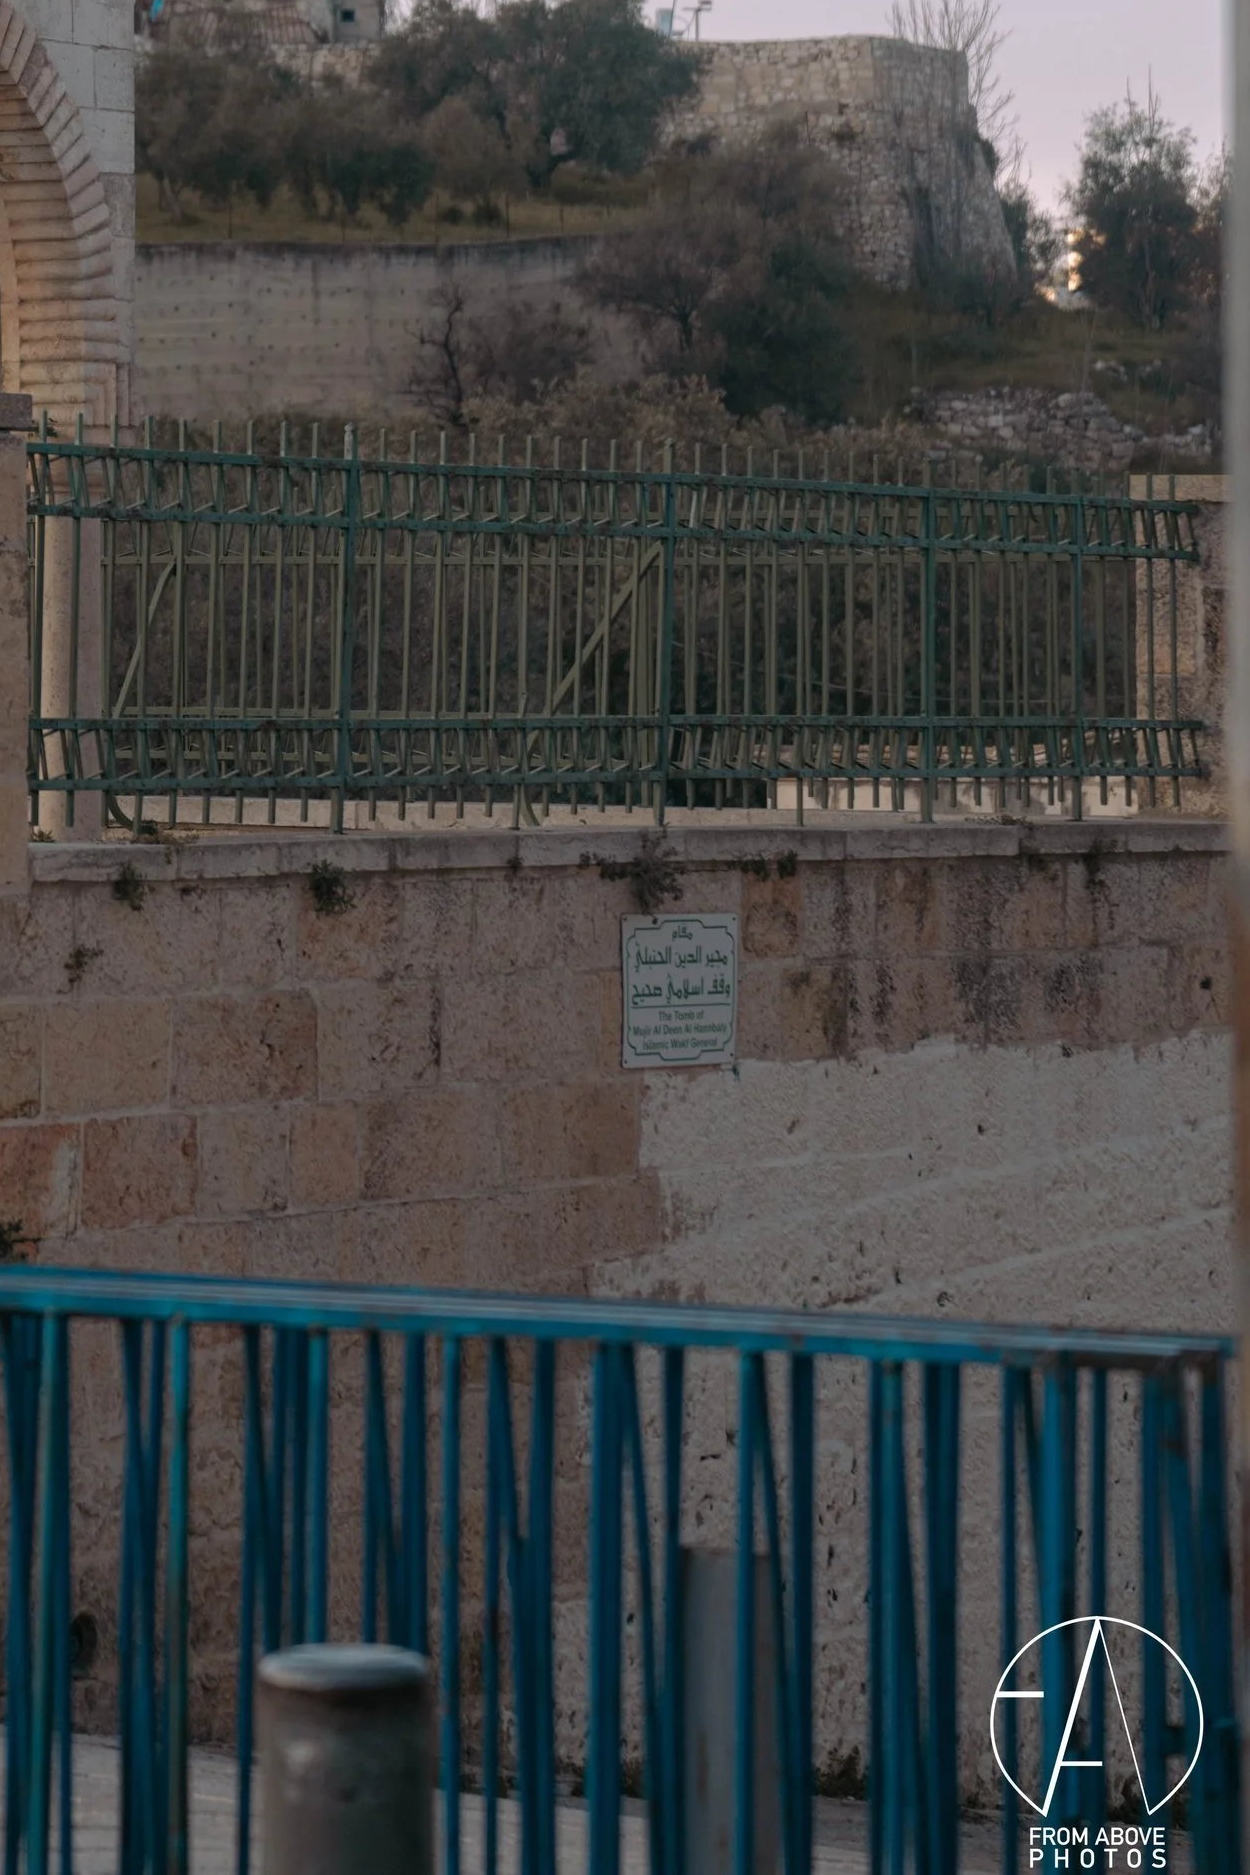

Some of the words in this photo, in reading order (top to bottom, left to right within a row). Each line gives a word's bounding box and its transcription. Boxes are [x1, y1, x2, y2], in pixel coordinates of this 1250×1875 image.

[672, 925, 692, 941] مقام
[635, 941, 671, 973] الحنبلي
[675, 946, 702, 968] الدين
[706, 950, 727, 967] مجير
[632, 984, 662, 1005] صحيح
[659, 1011, 672, 1021] The
[675, 1010, 695, 1019] Tomb
[696, 1010, 704, 1019] of
[654, 1025, 661, 1034] Al
[664, 1025, 682, 1034] Deen
[685, 1024, 692, 1032] Al
[694, 1022, 727, 1033] Hannbaly
[643, 1041, 669, 1050] Islamic
[670, 1039, 688, 1048] Wakf
[691, 1037, 717, 1048] General
